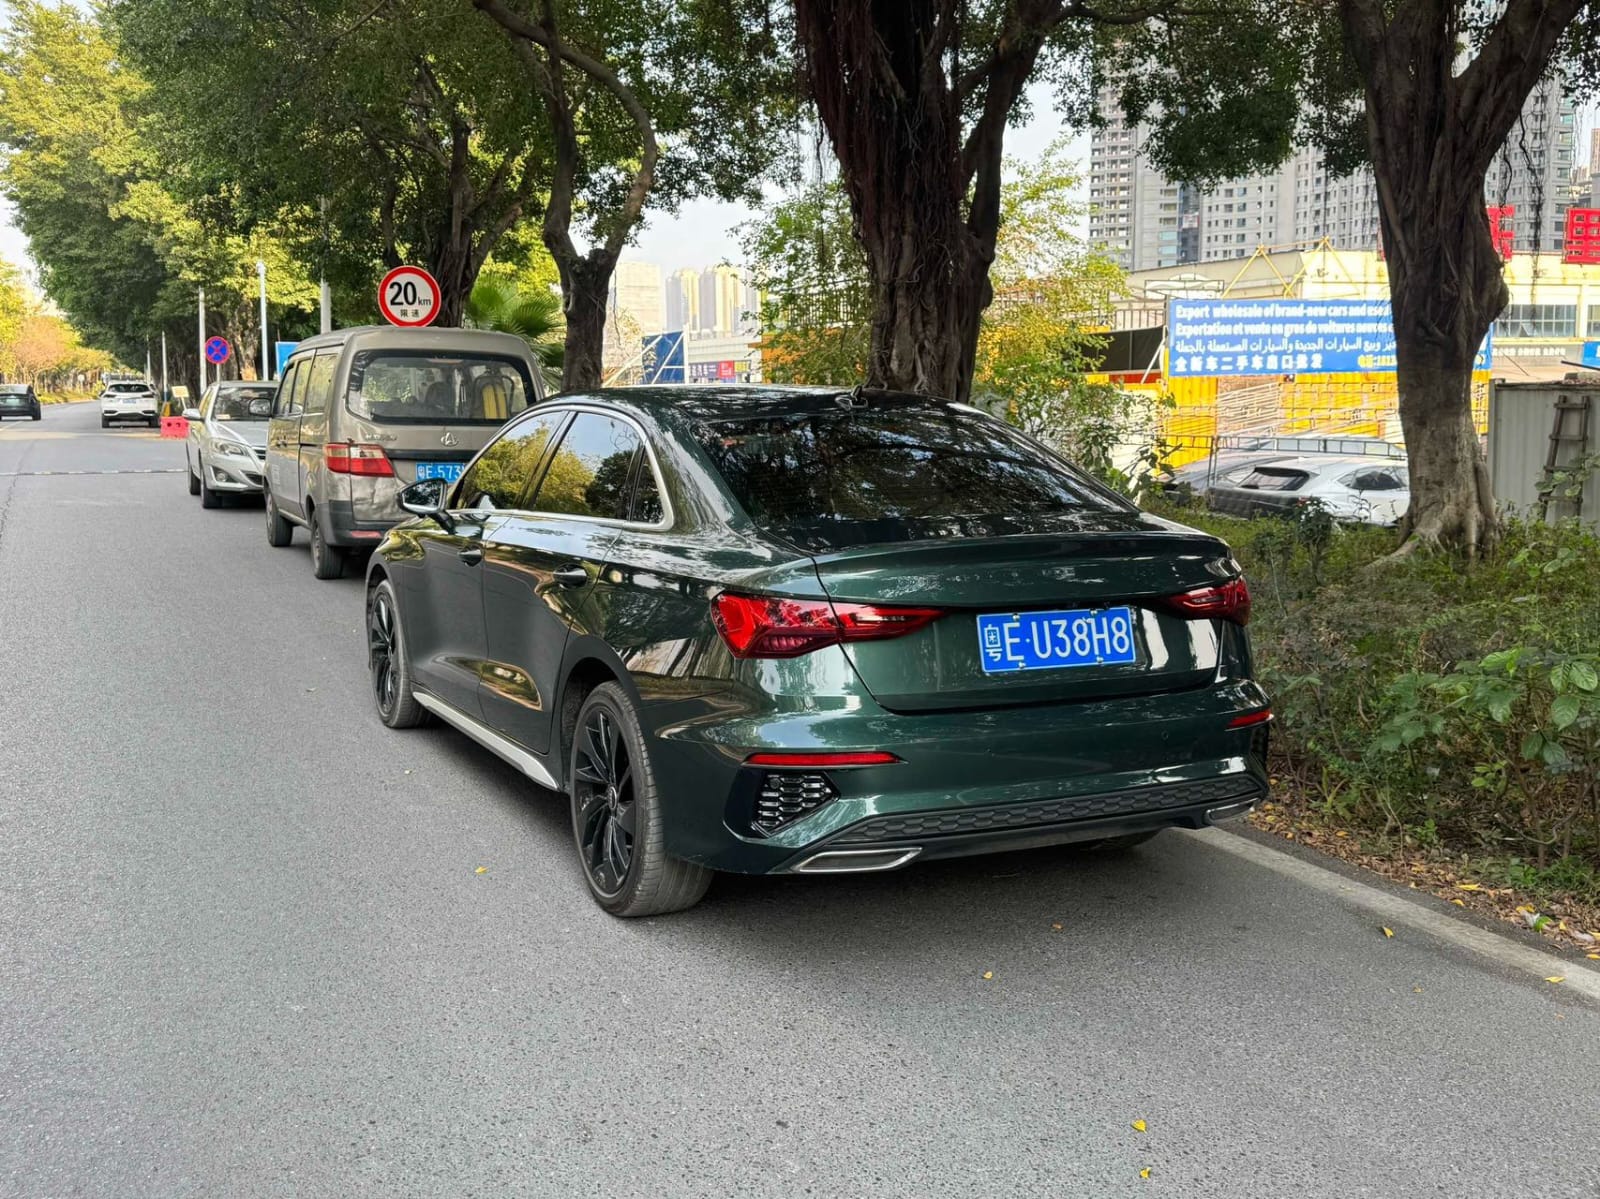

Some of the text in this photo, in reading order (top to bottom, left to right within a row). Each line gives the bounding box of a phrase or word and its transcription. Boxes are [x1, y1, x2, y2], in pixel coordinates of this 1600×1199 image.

[1176, 304, 1210, 320] Export
[1213, 303, 1263, 318] wholesale
[1264, 303, 1275, 317] of
[1275, 303, 1327, 317] brand-new
[1328, 306, 1347, 317] cars
[1348, 303, 1366, 316] and
[1176, 321, 1232, 338] Exportation
[1232, 322, 1243, 335] et
[1244, 322, 1271, 335] vente
[1271, 324, 1283, 335] en
[1284, 323, 1304, 338] gros
[1305, 320, 1317, 334] de
[1318, 320, 1355, 334] voitures
[1295, 337, 1324, 352] الجديدة
[1325, 336, 1362, 353] السيارات
